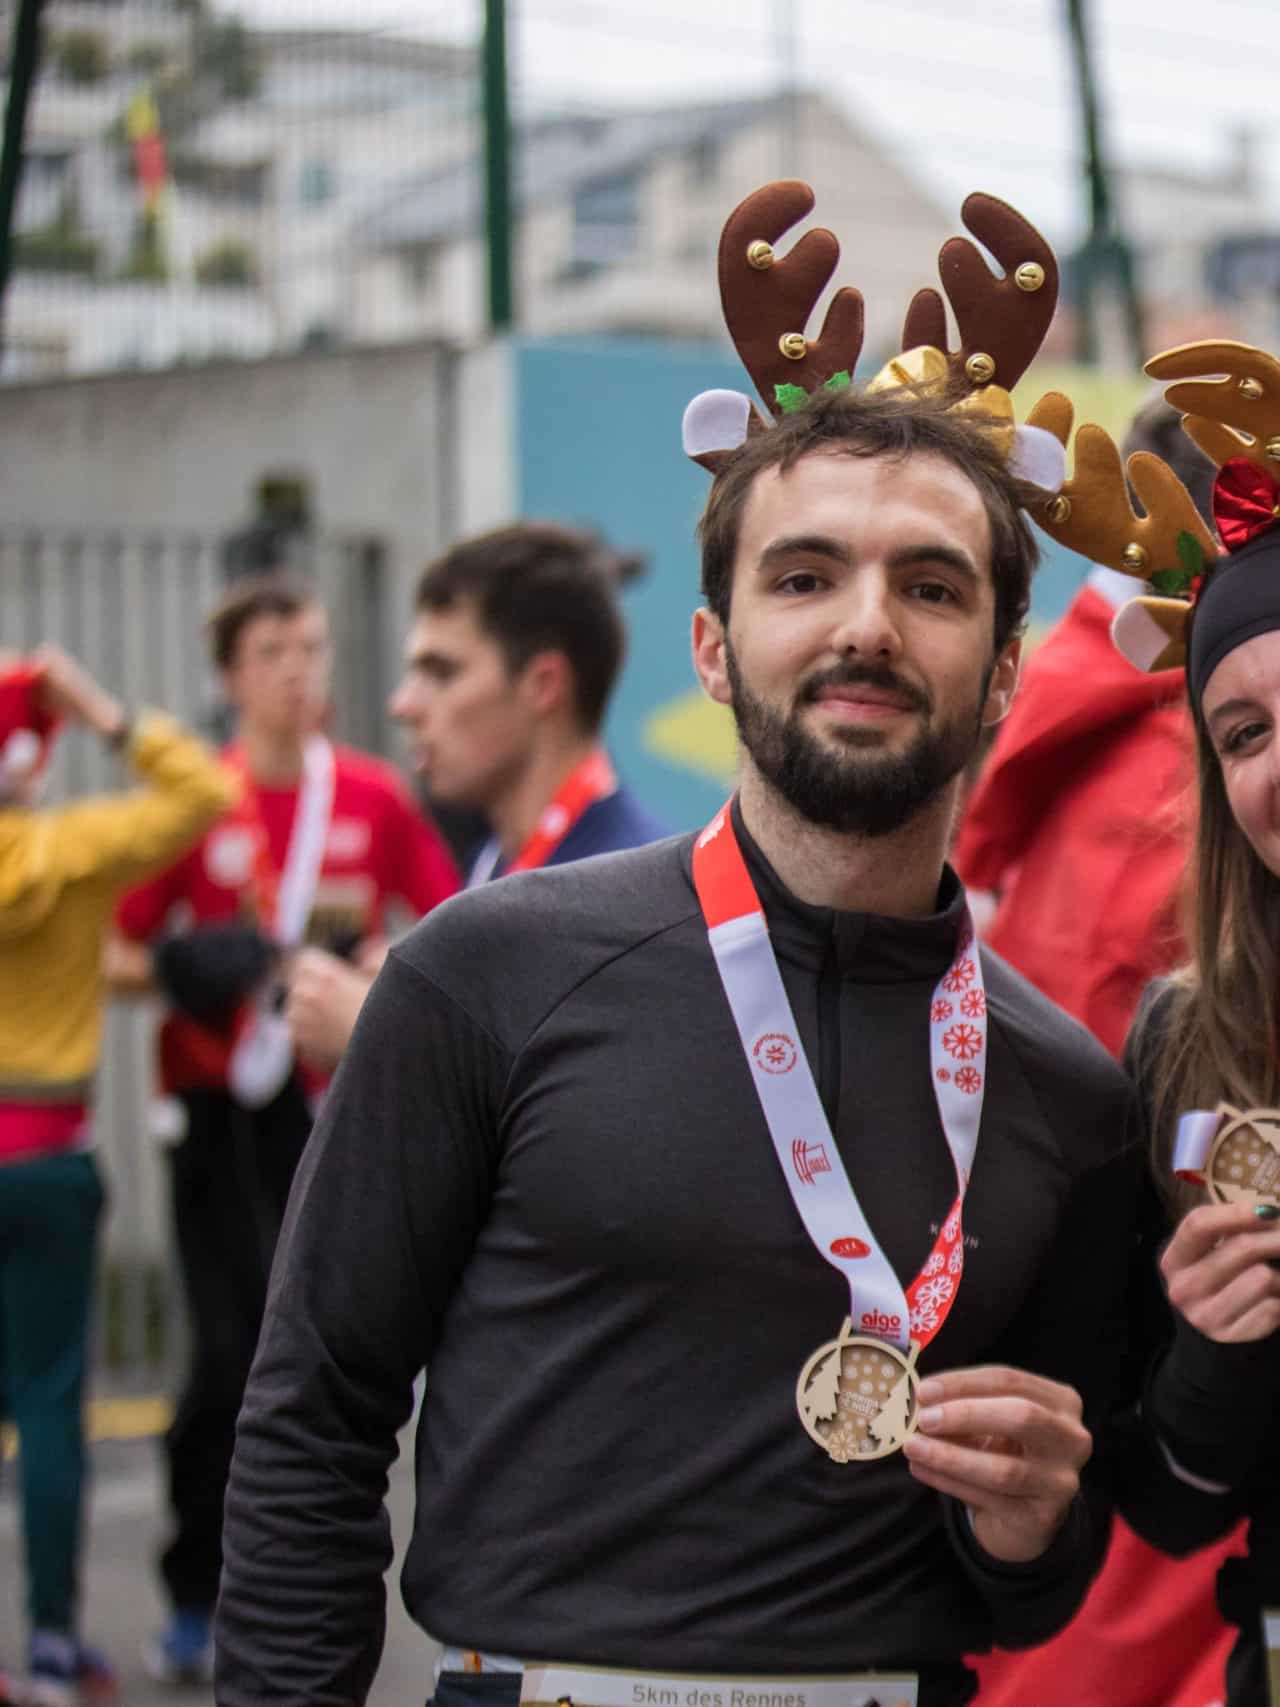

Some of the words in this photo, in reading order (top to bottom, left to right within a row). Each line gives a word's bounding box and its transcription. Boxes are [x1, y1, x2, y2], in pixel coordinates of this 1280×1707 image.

[861, 1307, 901, 1332] aigo
[632, 1683, 679, 1706] 5km
[686, 1688, 723, 1707] des
[731, 1688, 807, 1707] Rennes
